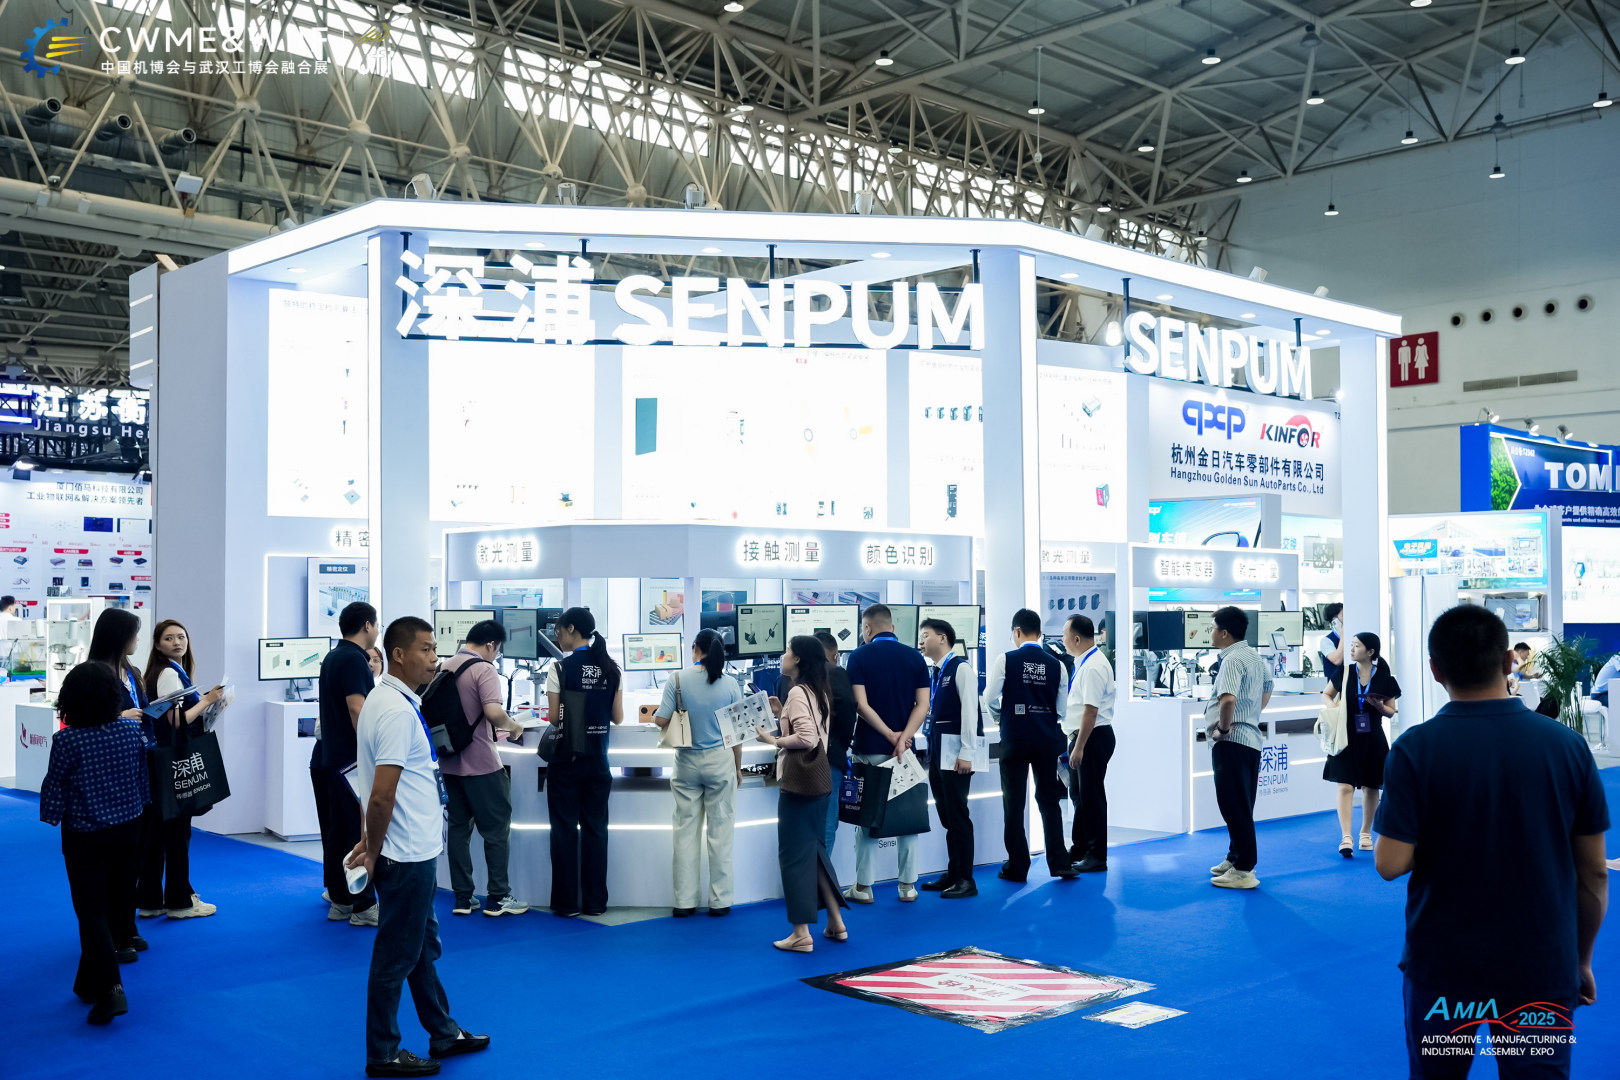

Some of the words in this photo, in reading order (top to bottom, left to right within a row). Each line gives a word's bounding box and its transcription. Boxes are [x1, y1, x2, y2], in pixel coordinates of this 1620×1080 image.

[395, 250, 596, 345] 深浦
[611, 274, 985, 350] SENPUM
[1123, 310, 1313, 400] SENPUM
[34, 418, 112, 438] Jiangsu
[1260, 415, 1321, 449] KINFOR
[1171, 442, 1325, 482] 杭州金日汽车零部件有限公司
[57, 481, 144, 495] 厦门佰马科技有限公司
[1170, 466, 1212, 483] Hangzhou
[1214, 472, 1242, 486] Golden
[1244, 475, 1259, 488] Sun
[1260, 478, 1297, 493] AutoParts
[1313, 482, 1324, 495] Ltd
[27, 491, 144, 506] 工业物联网&解决方案领先者
[478, 541, 533, 564] 激光测量
[743, 539, 820, 563] 接触测量
[866, 543, 934, 566] 颜色识别
[1022, 673, 1047, 681] SENPUM
[1023, 661, 1046, 676] 深浦
[1258, 743, 1288, 773] 深浦
[1258, 773, 1288, 787] SENPUM
